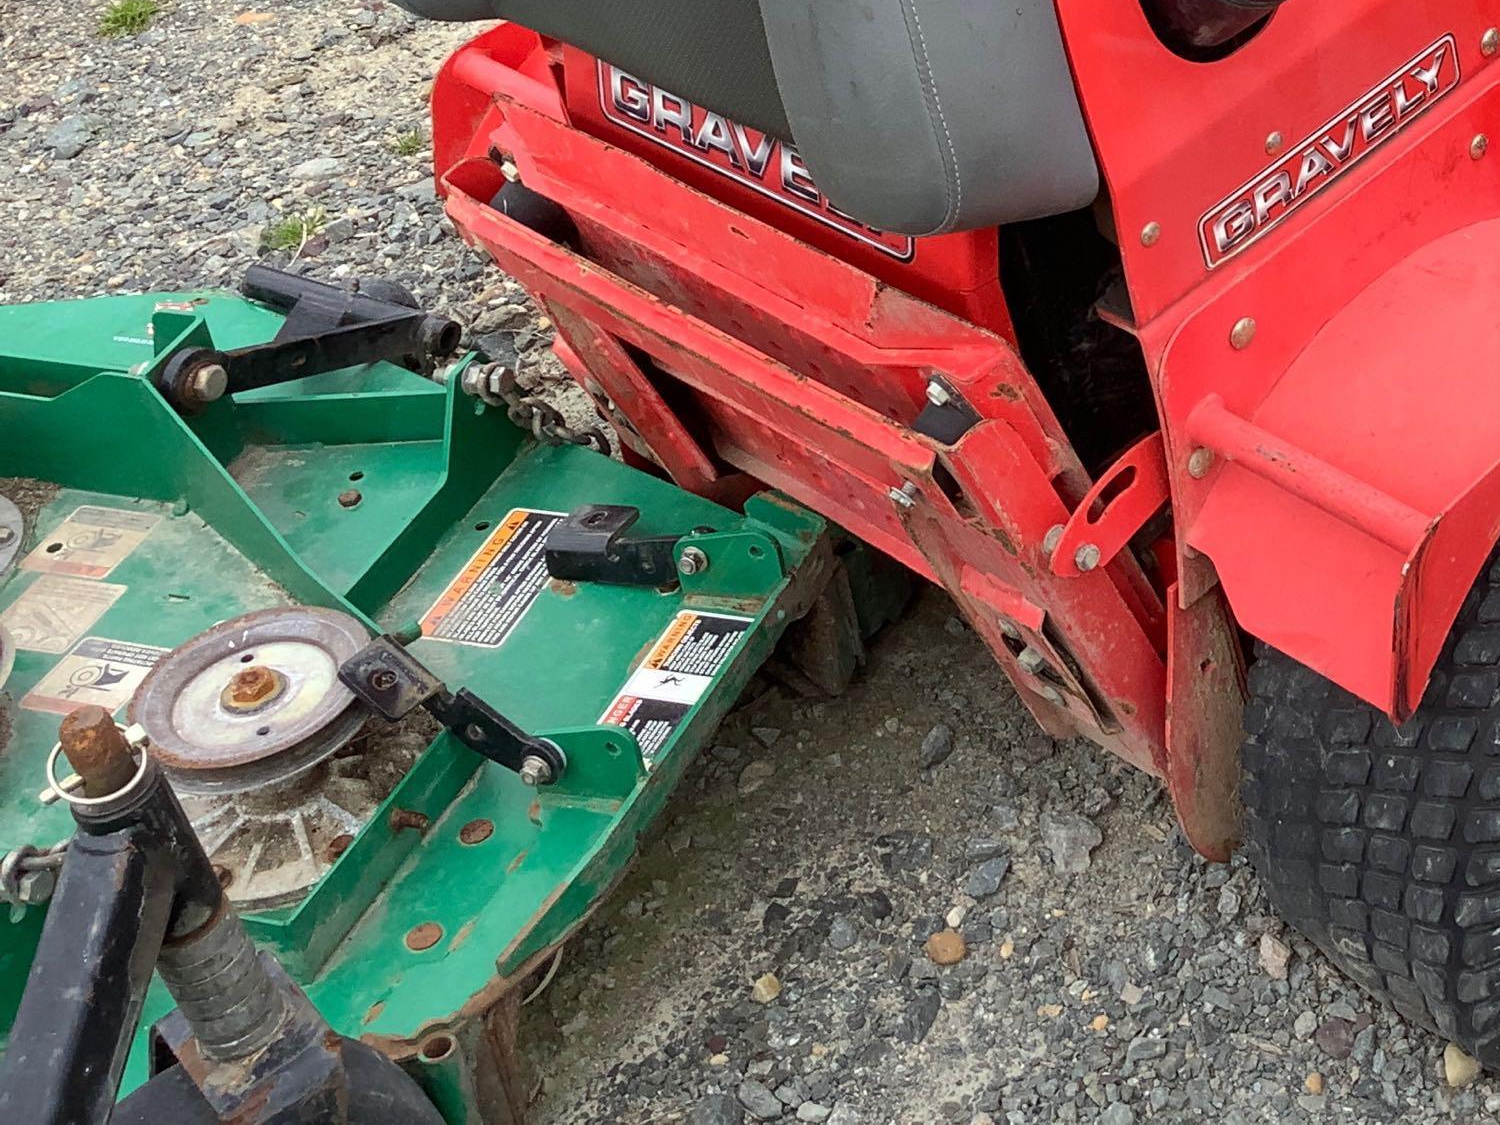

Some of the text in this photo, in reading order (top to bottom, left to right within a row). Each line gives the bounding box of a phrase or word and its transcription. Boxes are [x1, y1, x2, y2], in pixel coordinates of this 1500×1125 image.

[610, 64, 882, 235] GRAVE
[1212, 46, 1448, 253] GRAVELY
[440, 537, 505, 610] WARNING
[656, 614, 693, 661] WARNING
